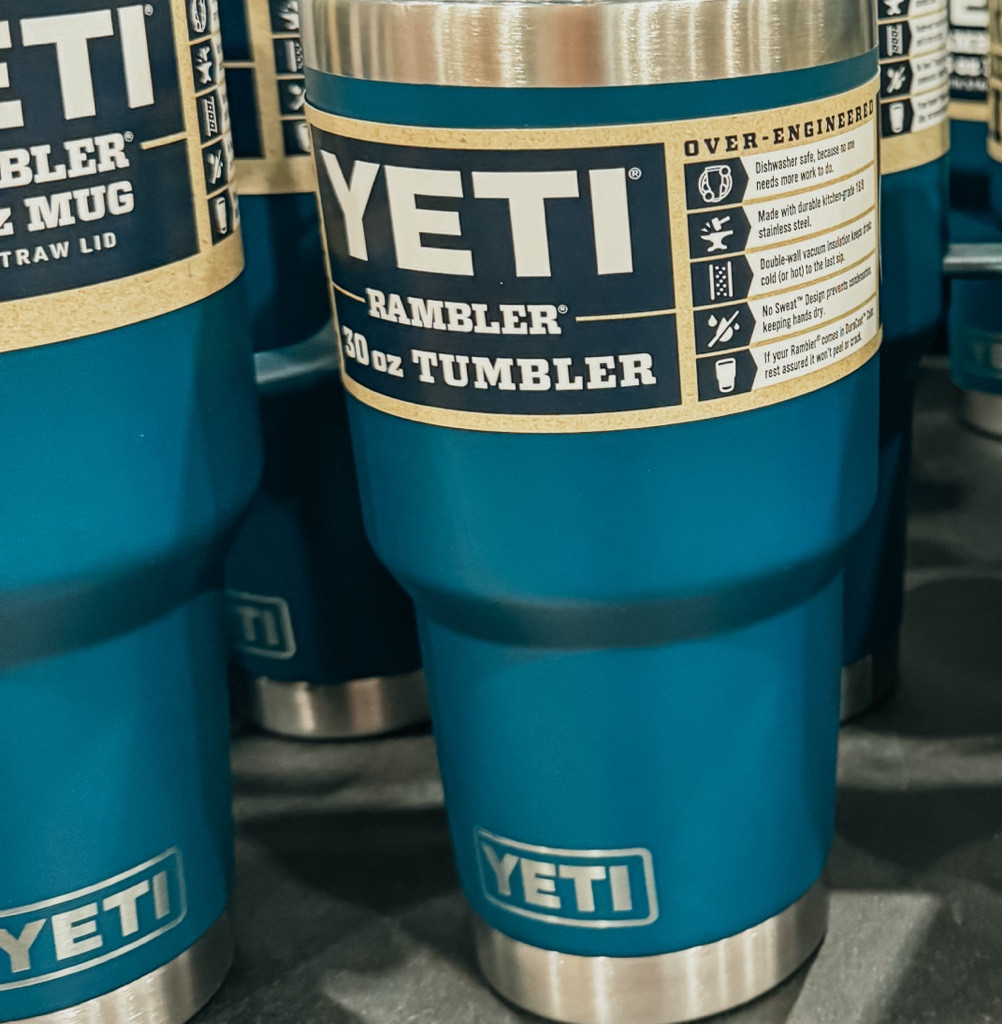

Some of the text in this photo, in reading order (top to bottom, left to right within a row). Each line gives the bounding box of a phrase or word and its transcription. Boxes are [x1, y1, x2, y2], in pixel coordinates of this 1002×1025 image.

[684, 99, 874, 157] OVER-ENGINEERED
[755, 156, 798, 174] Dishwasher
[799, 151, 816, 166] safe,
[756, 175, 779, 191] needs
[780, 173, 799, 186] more
[800, 166, 817, 182] work
[24, 180, 135, 232] MUG
[758, 209, 779, 223] Made
[780, 202, 797, 218] with
[798, 197, 821, 214] durable
[79, 231, 117, 254] LID
[758, 222, 792, 239] stainless
[760, 249, 802, 271] Double-wall
[803, 244, 826, 259] vacuum
[760, 272, 777, 287] cold
[778, 269, 789, 285] (or
[790, 265, 805, 279] hot)
[805, 263, 813, 275] to
[813, 259, 824, 271] the
[824, 255, 836, 269] last
[762, 304, 774, 318] No
[804, 289, 826, 305] Design
[762, 317, 792, 333] keeping
[792, 309, 812, 325] hands
[341, 325, 657, 392] 30 oz TUMBLER
[764, 350, 771, 364] If
[772, 347, 790, 364] your
[821, 330, 839, 344] comes
[764, 366, 780, 380] rest
[781, 355, 809, 375] assured
[482, 845, 632, 913] YETI
[0, 869, 171, 974] YETI
